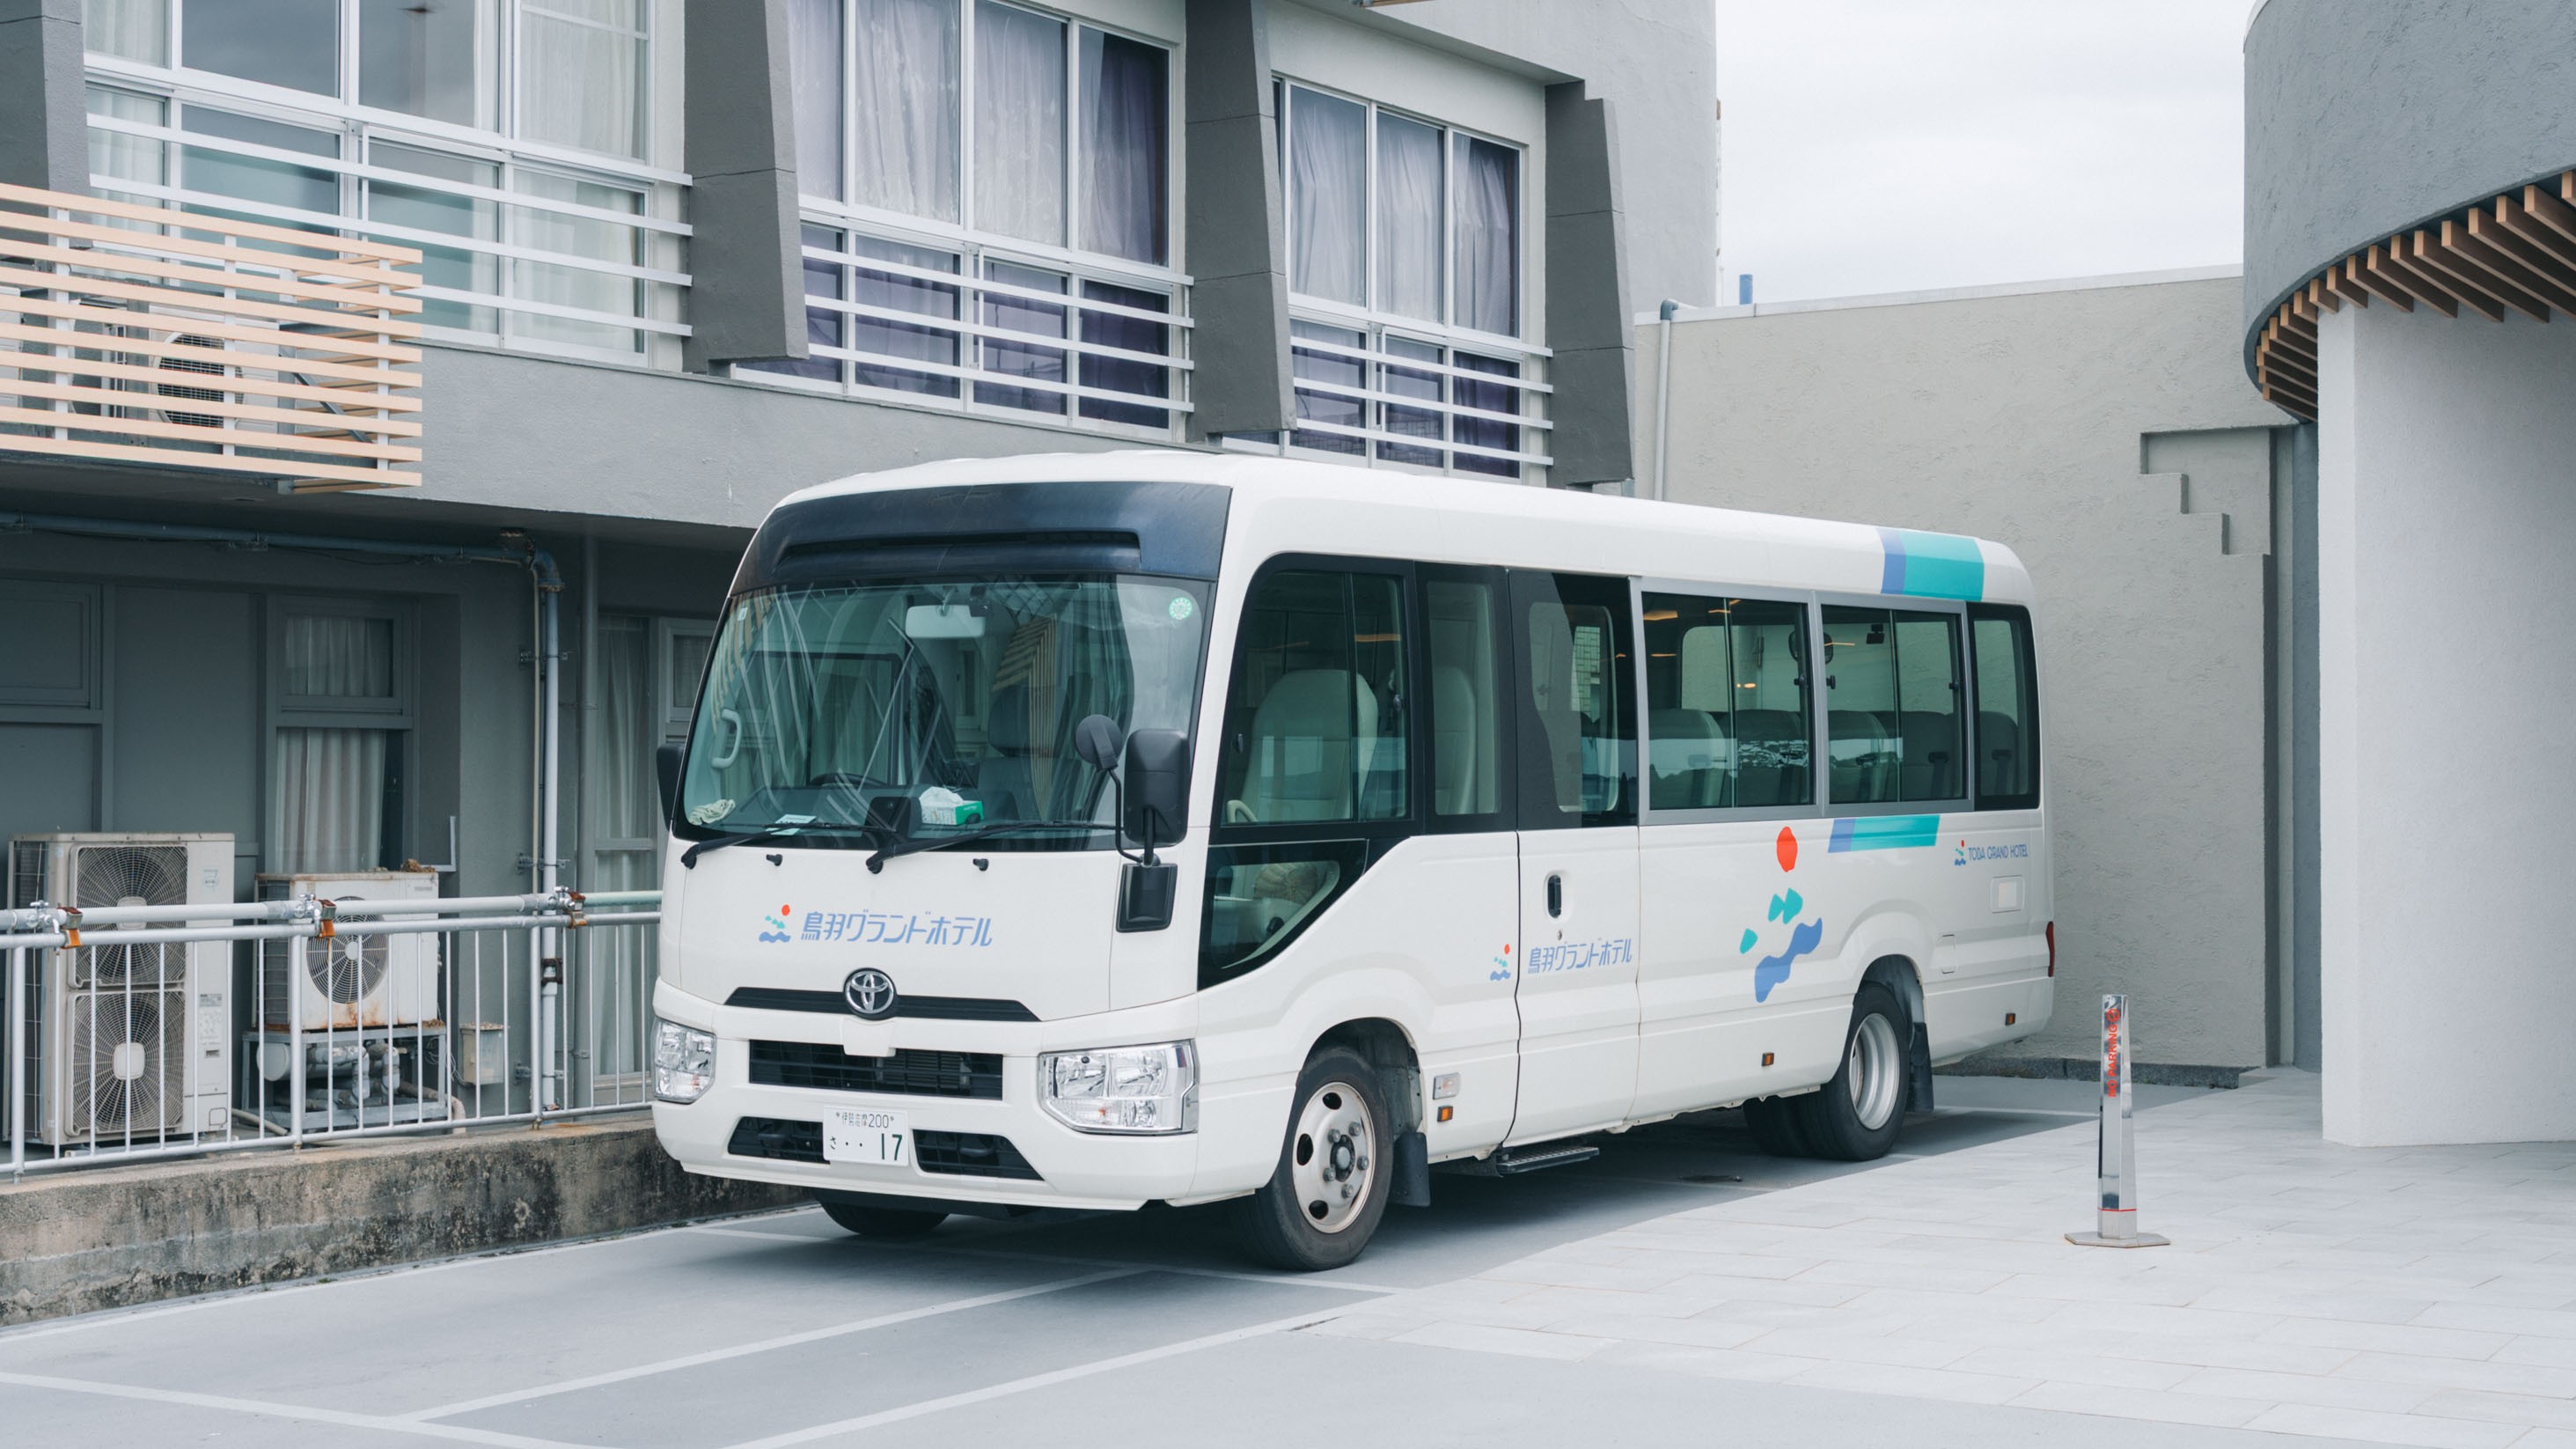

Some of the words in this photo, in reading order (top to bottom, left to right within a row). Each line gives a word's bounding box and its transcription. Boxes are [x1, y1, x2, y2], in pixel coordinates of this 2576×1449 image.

[1987, 845, 2009, 860] GRAND
[2010, 844, 2028, 857] HOTEL
[800, 908, 993, 947] 鳥羽グランドホテル
[1527, 937, 1633, 975] 鳥羽グランドホテル
[2108, 1024, 2118, 1078] PARKING
[2107, 1079, 2117, 1097] NO
